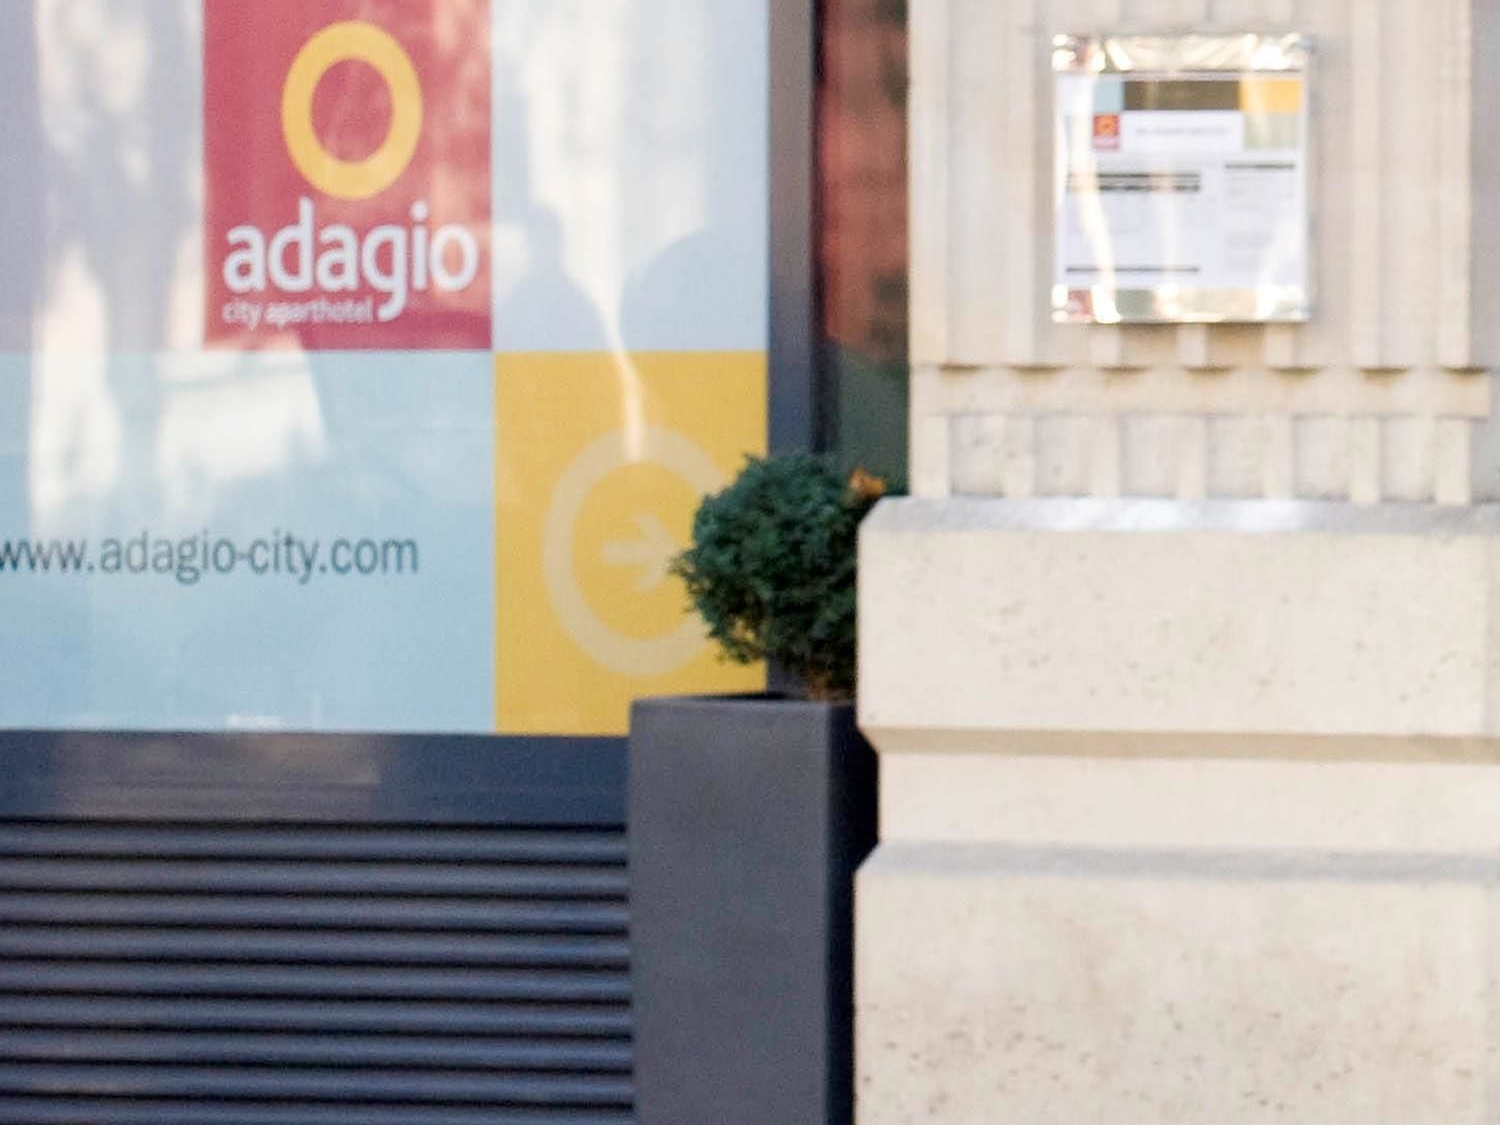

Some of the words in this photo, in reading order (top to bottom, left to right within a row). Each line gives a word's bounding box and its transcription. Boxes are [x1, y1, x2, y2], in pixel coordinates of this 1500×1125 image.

[222, 197, 478, 322] adagio
[221, 296, 262, 331] city
[264, 295, 374, 329] aparthotel
[0, 528, 419, 585] www.adagio-city.com
